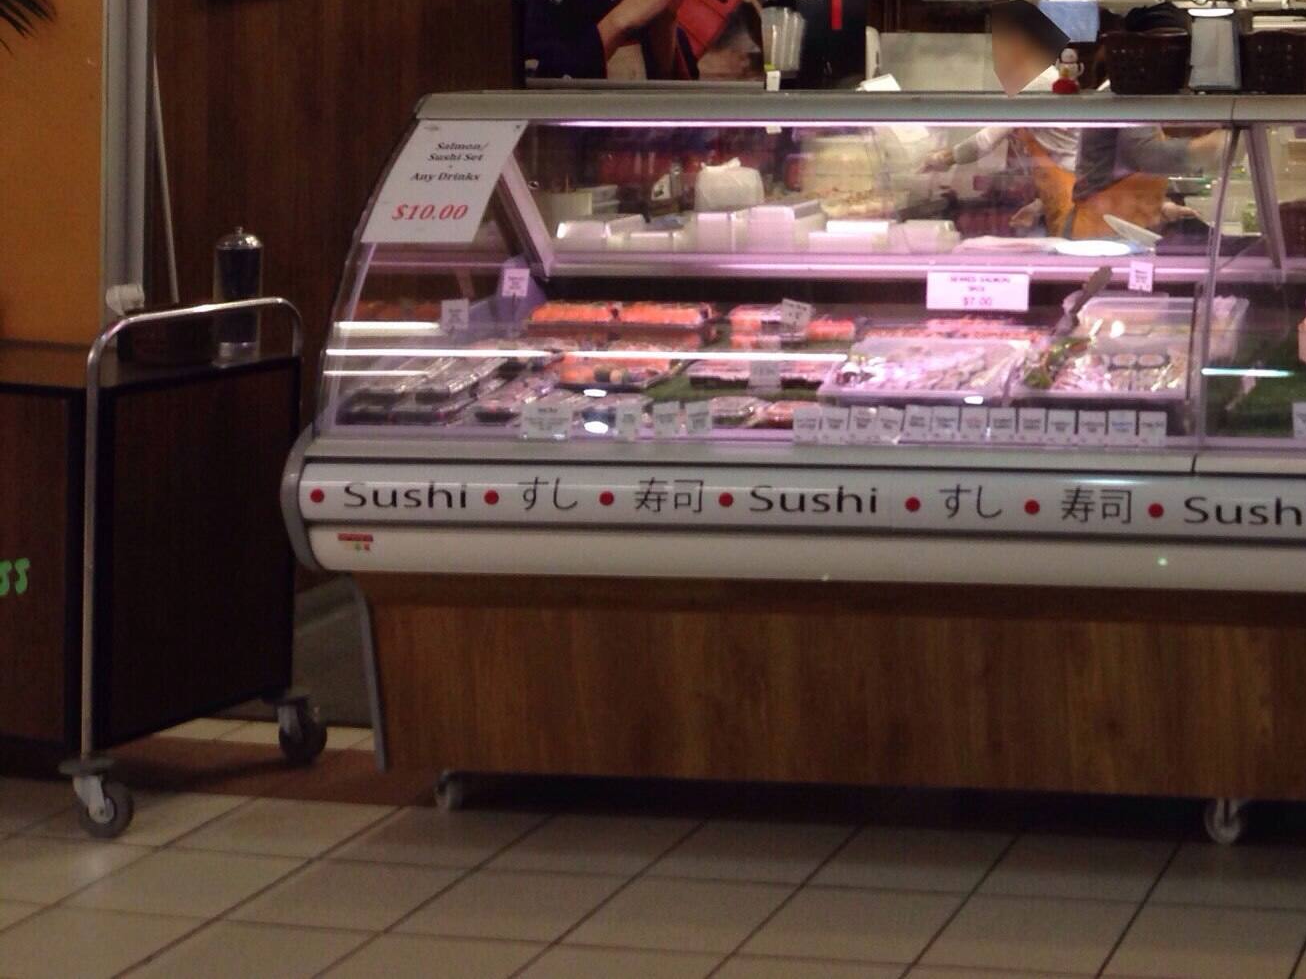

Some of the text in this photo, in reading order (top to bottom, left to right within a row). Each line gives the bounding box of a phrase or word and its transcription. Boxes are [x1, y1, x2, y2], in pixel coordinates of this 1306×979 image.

[428, 152, 484, 162] Sushi Set
[410, 172, 481, 183] Any Drinks
[391, 203, 469, 221] $10.00
[343, 481, 467, 509] Sushi
[518, 477, 578, 511] すし
[634, 477, 704, 513] 寿司
[749, 484, 878, 514] Sushi
[940, 484, 1002, 519] すし
[1060, 486, 1132, 524] 寿司
